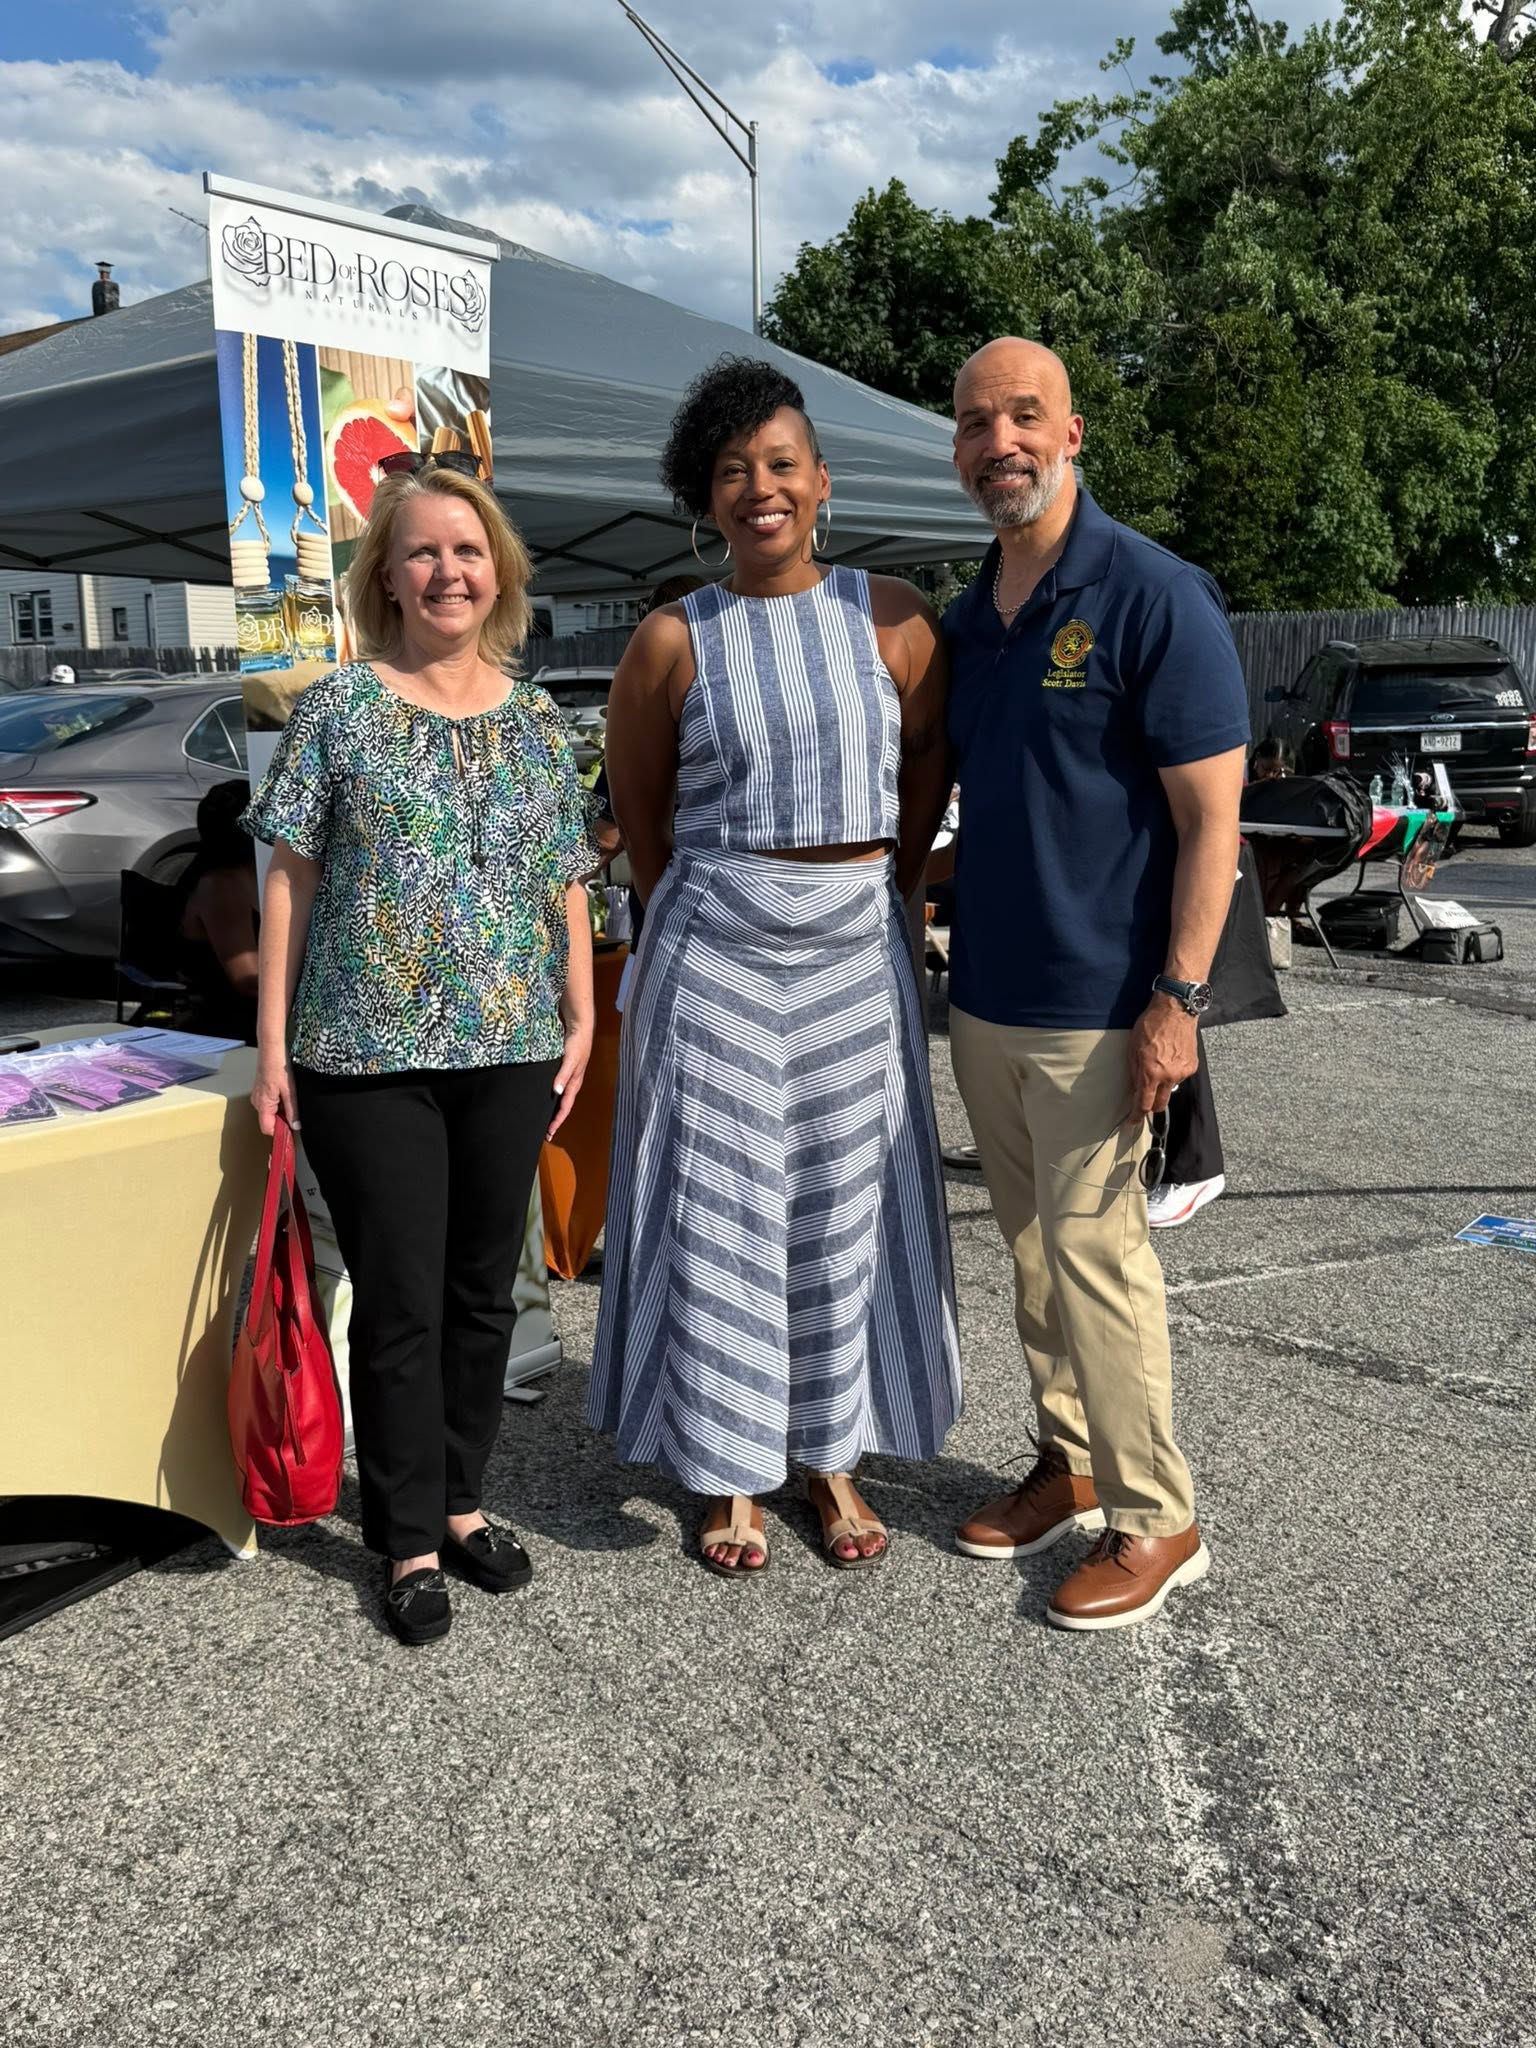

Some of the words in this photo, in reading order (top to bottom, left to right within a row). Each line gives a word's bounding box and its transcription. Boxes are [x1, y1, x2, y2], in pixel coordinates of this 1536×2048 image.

[262, 232, 337, 285] BED
[355, 252, 469, 316] ROSES
[1047, 668, 1086, 679] Legislator
[1042, 679, 1063, 687] Scott
